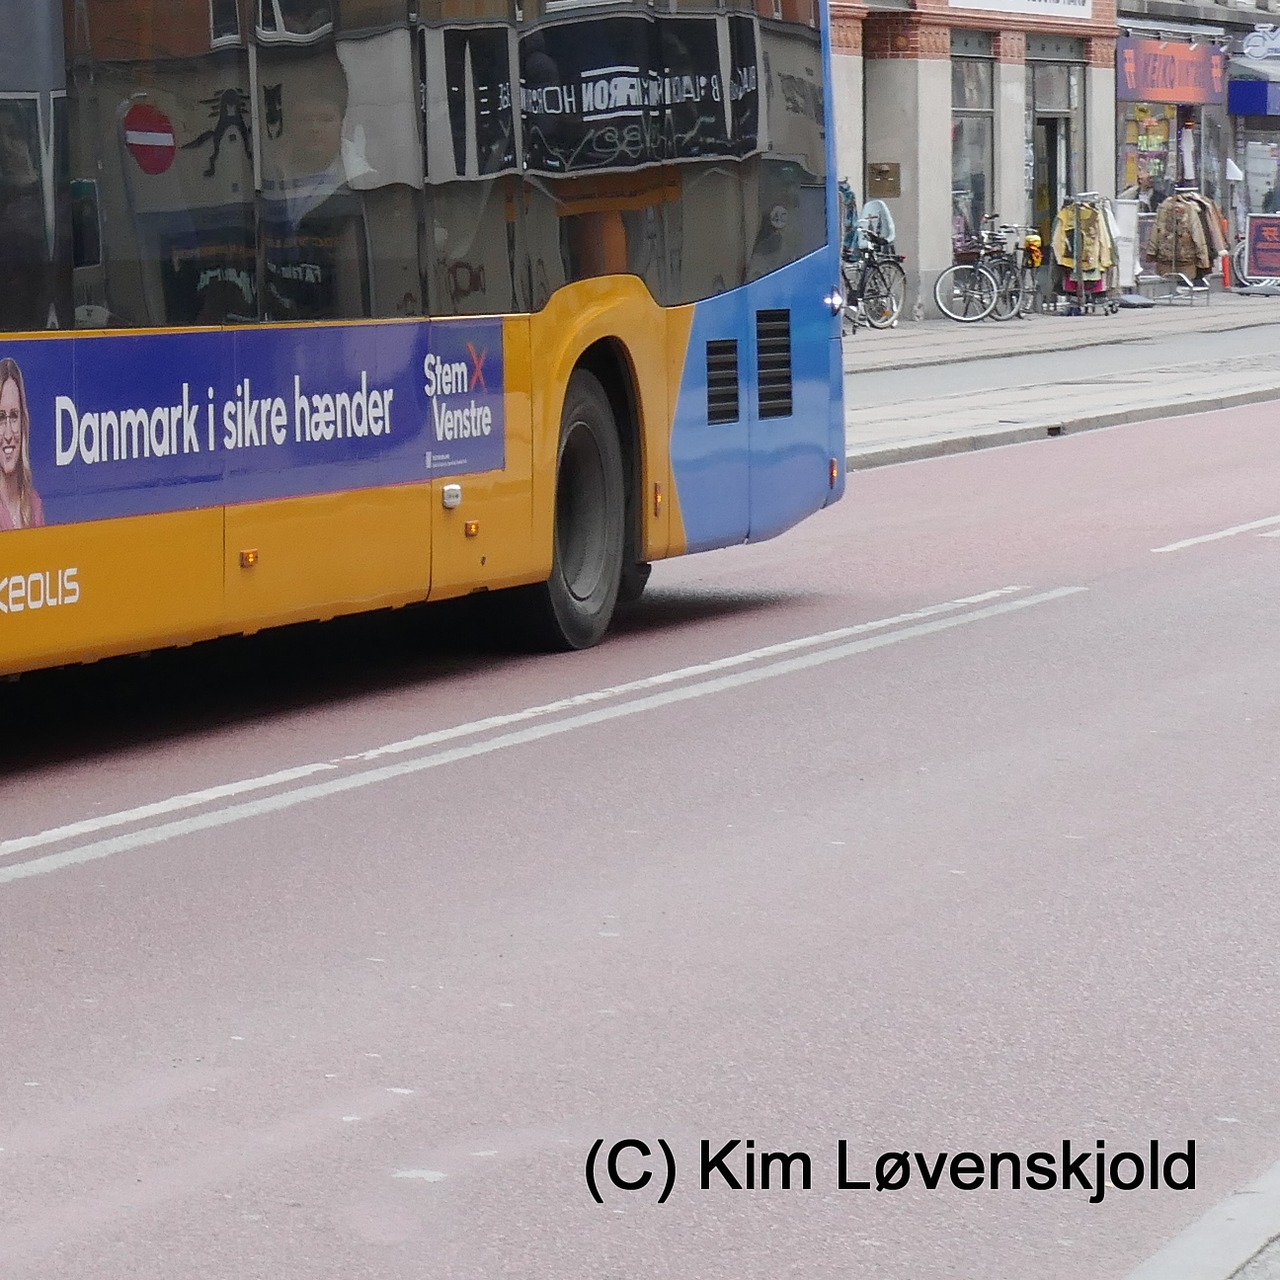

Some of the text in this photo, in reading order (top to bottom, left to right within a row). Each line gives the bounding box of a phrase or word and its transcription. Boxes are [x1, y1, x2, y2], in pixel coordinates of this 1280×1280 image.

[424, 353, 468, 398] Stem
[55, 371, 394, 466] Danmark i sikre hænder
[432, 396, 492, 443] Venstre
